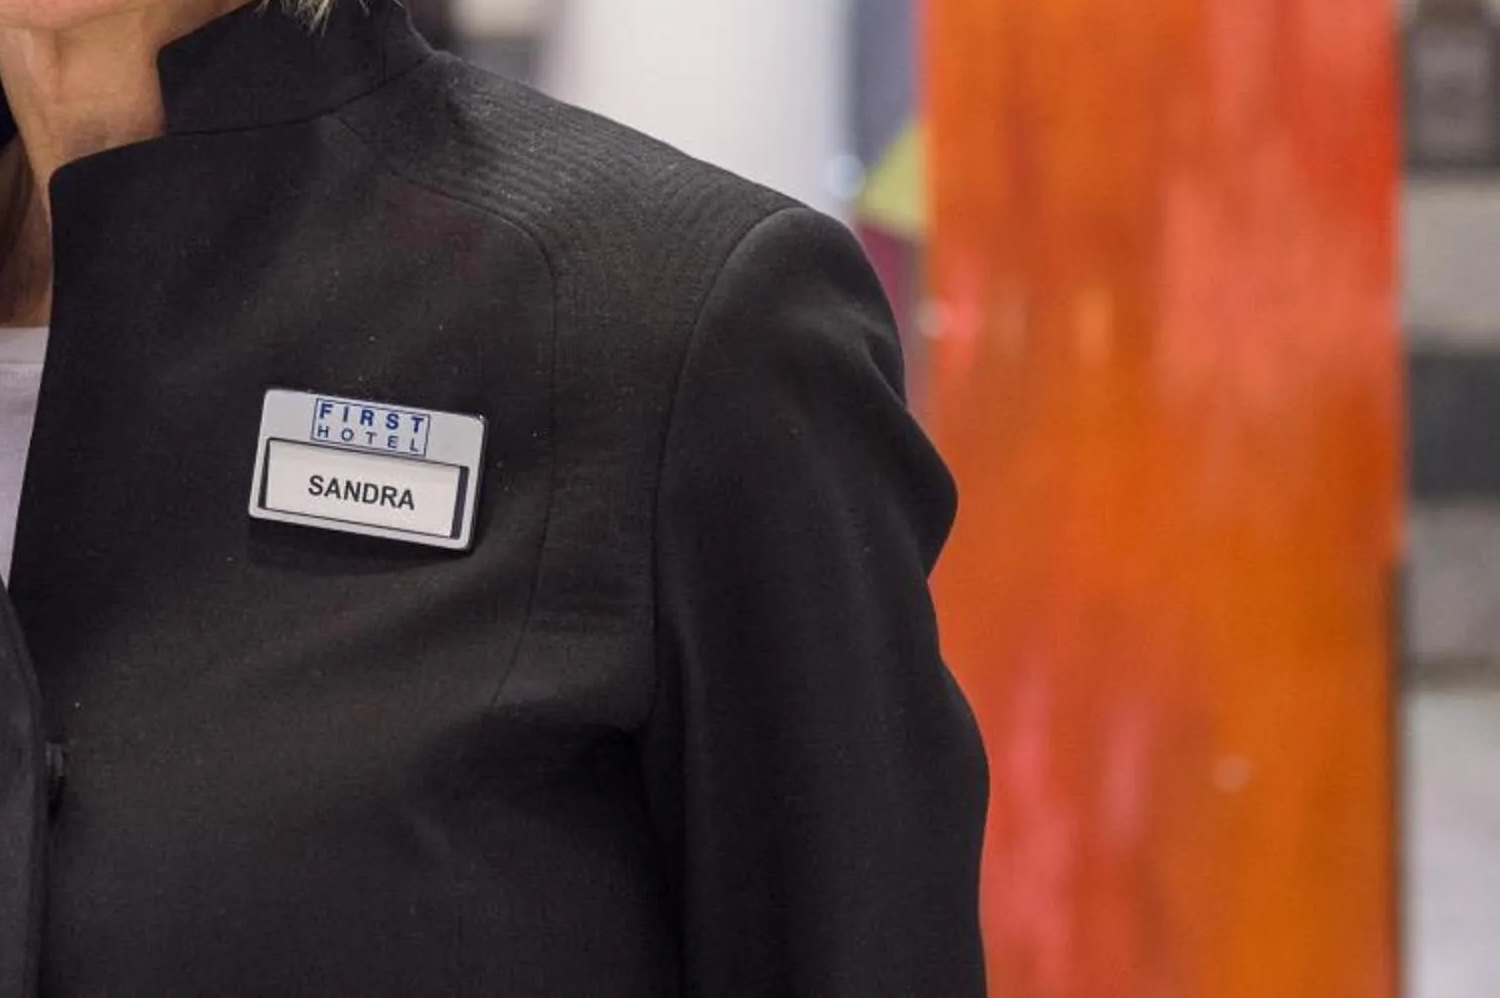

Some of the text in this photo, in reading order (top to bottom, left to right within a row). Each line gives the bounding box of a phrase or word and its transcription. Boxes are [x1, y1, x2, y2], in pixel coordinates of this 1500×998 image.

[318, 403, 425, 434] FIRST
[317, 425, 419, 453] HOTEL
[308, 474, 415, 511] SANDRA
